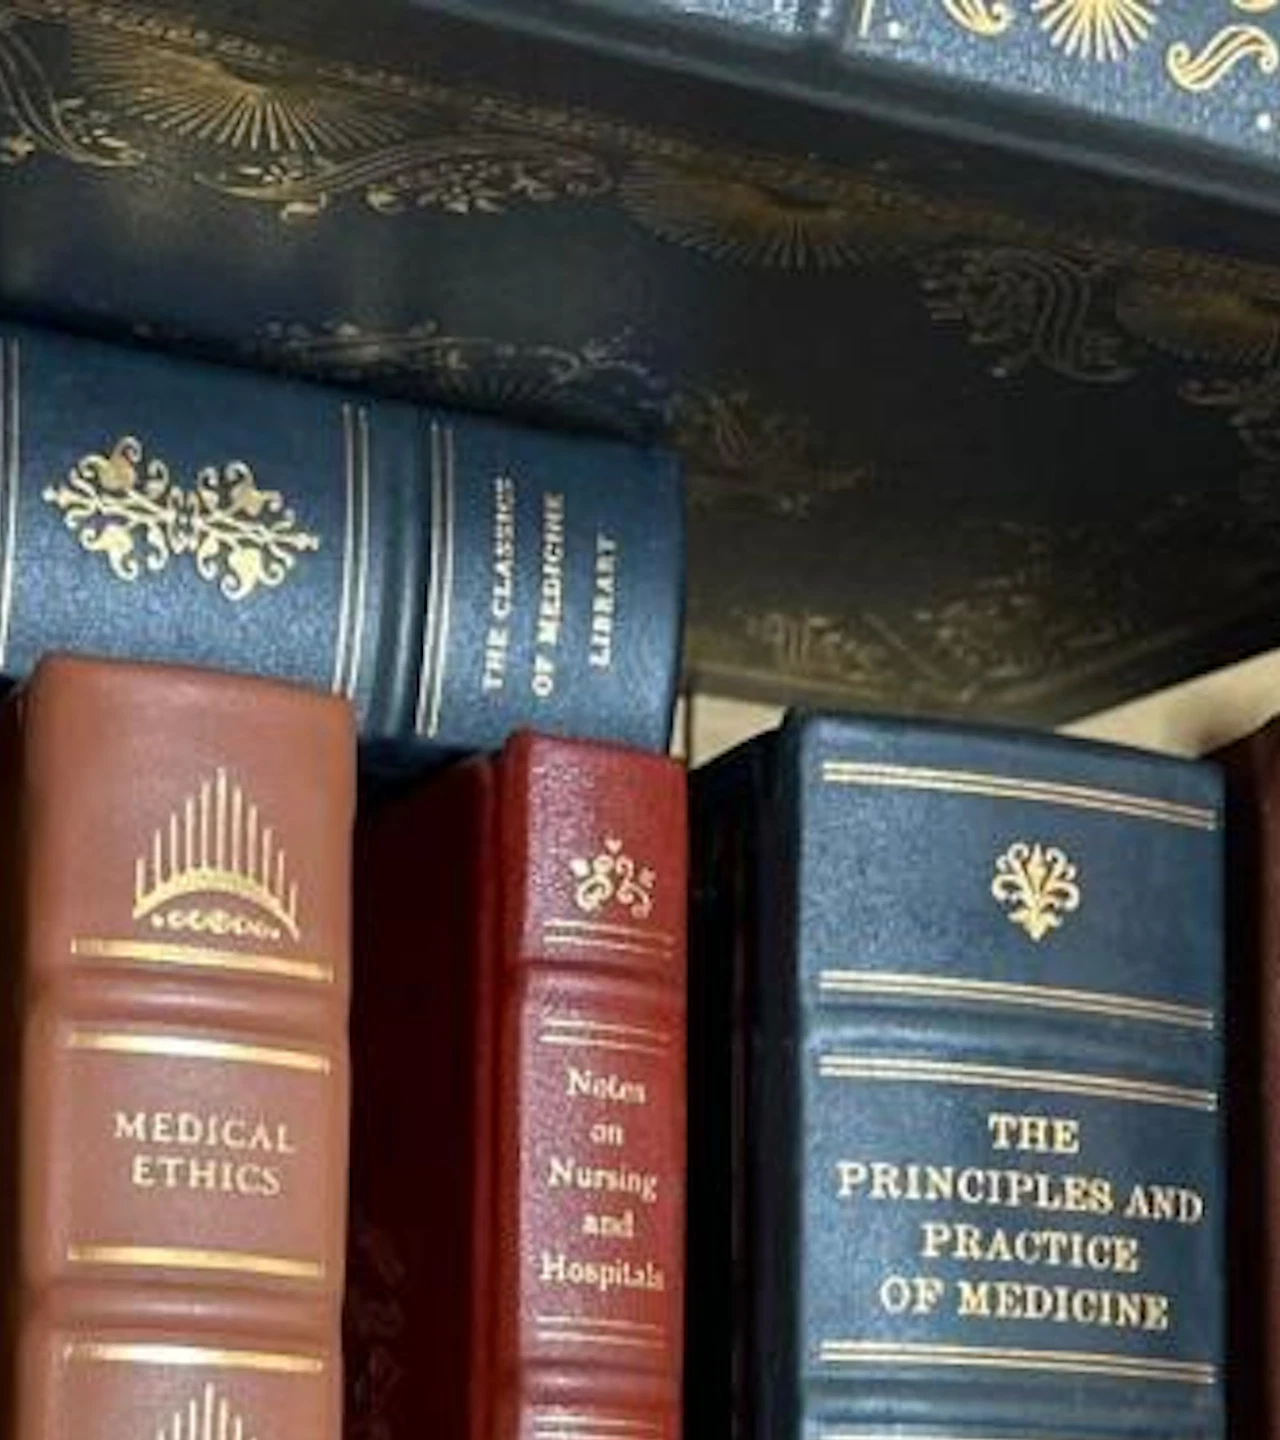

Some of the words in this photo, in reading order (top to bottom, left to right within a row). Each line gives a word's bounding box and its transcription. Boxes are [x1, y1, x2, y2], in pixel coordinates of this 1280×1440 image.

[483, 627, 508, 690] THE
[115, 1111, 296, 1154] MEDICAL
[589, 1121, 624, 1147] on
[988, 1112, 1080, 1155] THE
[131, 1154, 281, 1197] ETHICS
[547, 1156, 657, 1203] Nursing
[835, 1160, 1113, 1215] PRINCIPLES
[1124, 1183, 1204, 1225] AND
[581, 1210, 634, 1239] and
[921, 1221, 1140, 1274] PRACTICE
[880, 1274, 944, 1316] OF
[956, 1279, 1170, 1331] MEDICINE
